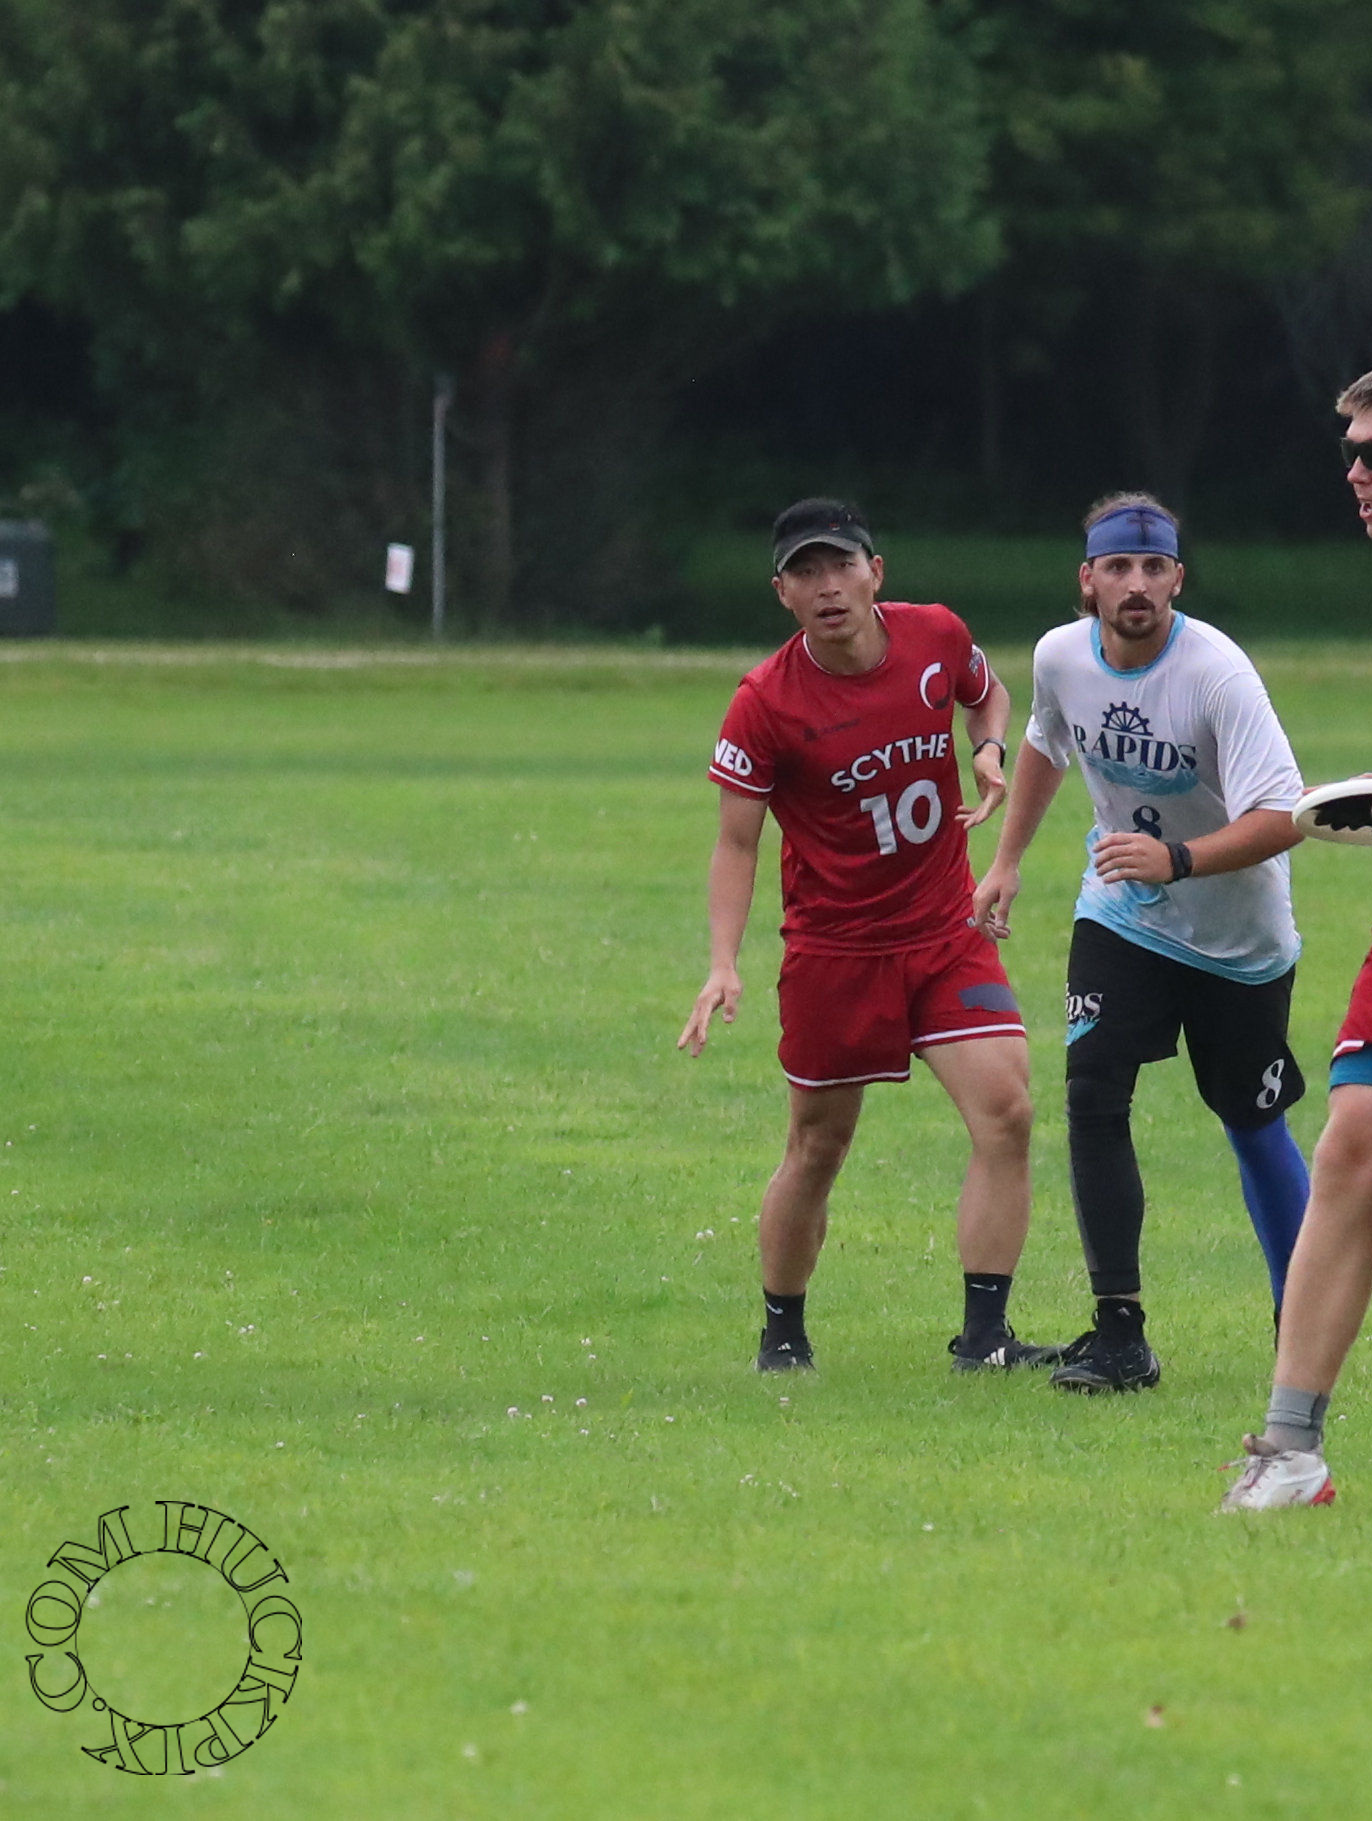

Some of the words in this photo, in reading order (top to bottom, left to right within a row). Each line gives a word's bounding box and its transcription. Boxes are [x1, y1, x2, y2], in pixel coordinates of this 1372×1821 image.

[830, 733, 950, 793] SCYTHE
[1073, 724, 1198, 771] RAPIDS
[860, 778, 943, 856] 10
[1132, 805, 1163, 840] 8
[1256, 1058, 1285, 1109] 8
